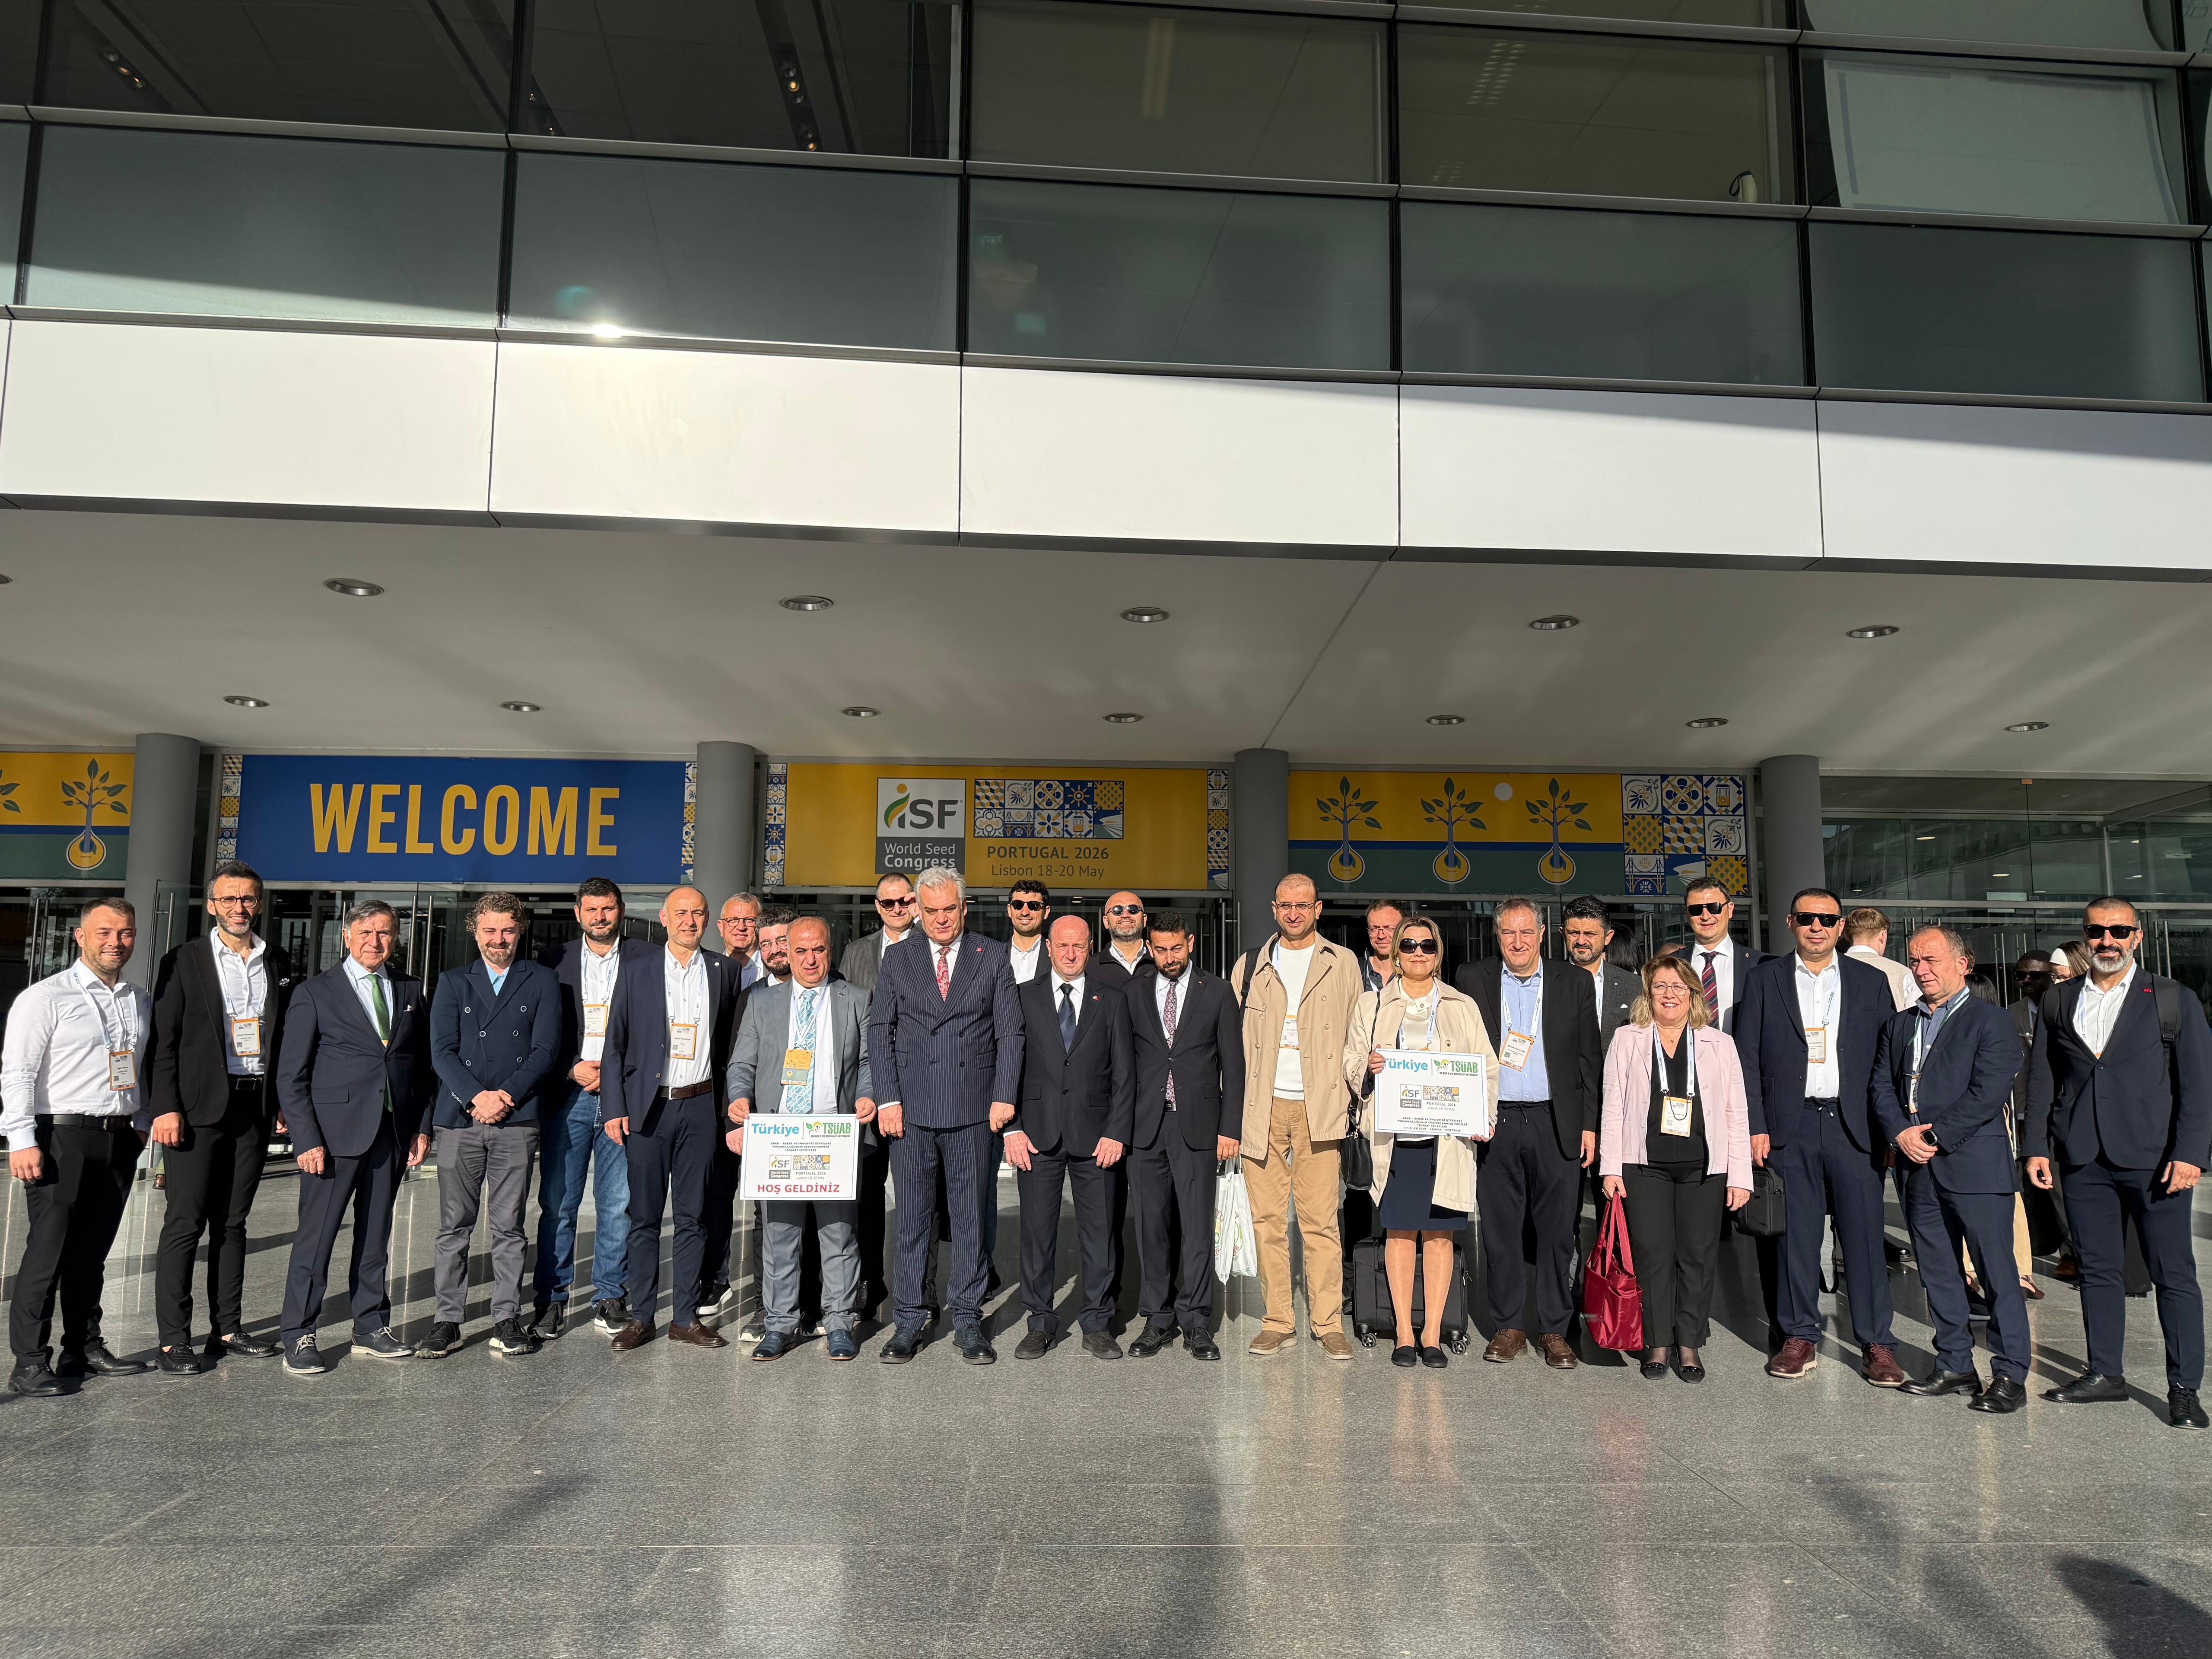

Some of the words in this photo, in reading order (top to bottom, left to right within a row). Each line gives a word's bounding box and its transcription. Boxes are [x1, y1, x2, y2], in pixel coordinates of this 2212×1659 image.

[310, 783, 619, 855] WELCOME
[884, 843, 921, 855] World
[926, 843, 955, 855] Seed
[987, 846, 1069, 859] PORTUGAL
[1075, 847, 1109, 859] 2026
[884, 855, 955, 871] Congress
[992, 864, 1033, 877] Lisbon
[1038, 865, 1074, 877] 18-20
[1080, 865, 1104, 879] May
[751, 1123, 799, 1137] Türkiye
[757, 1185, 781, 1194] HOŞ
[785, 1182, 840, 1192] GELDİNİZ
